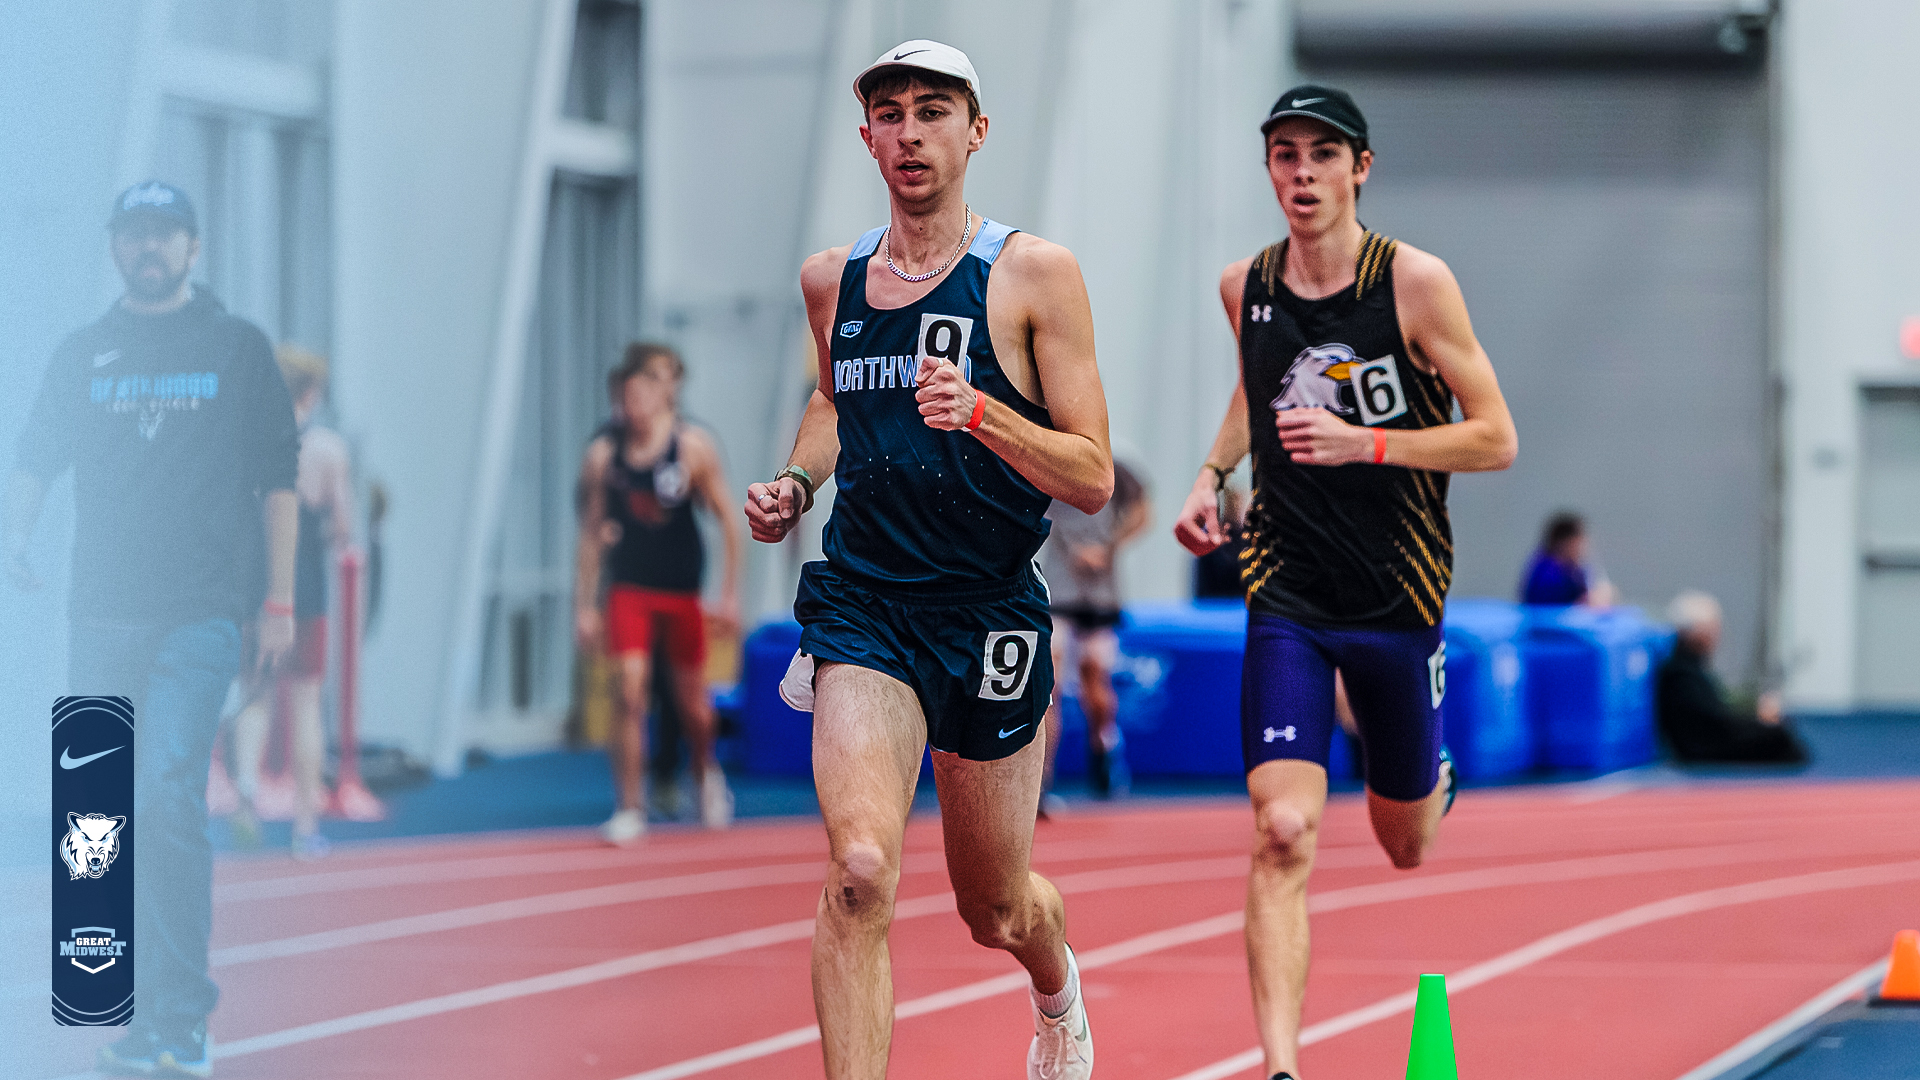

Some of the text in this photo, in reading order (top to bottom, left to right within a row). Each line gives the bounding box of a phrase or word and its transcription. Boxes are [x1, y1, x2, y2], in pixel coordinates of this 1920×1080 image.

[925, 319, 963, 367] 9
[1361, 366, 1396, 416] 6
[991, 634, 1030, 697] 9
